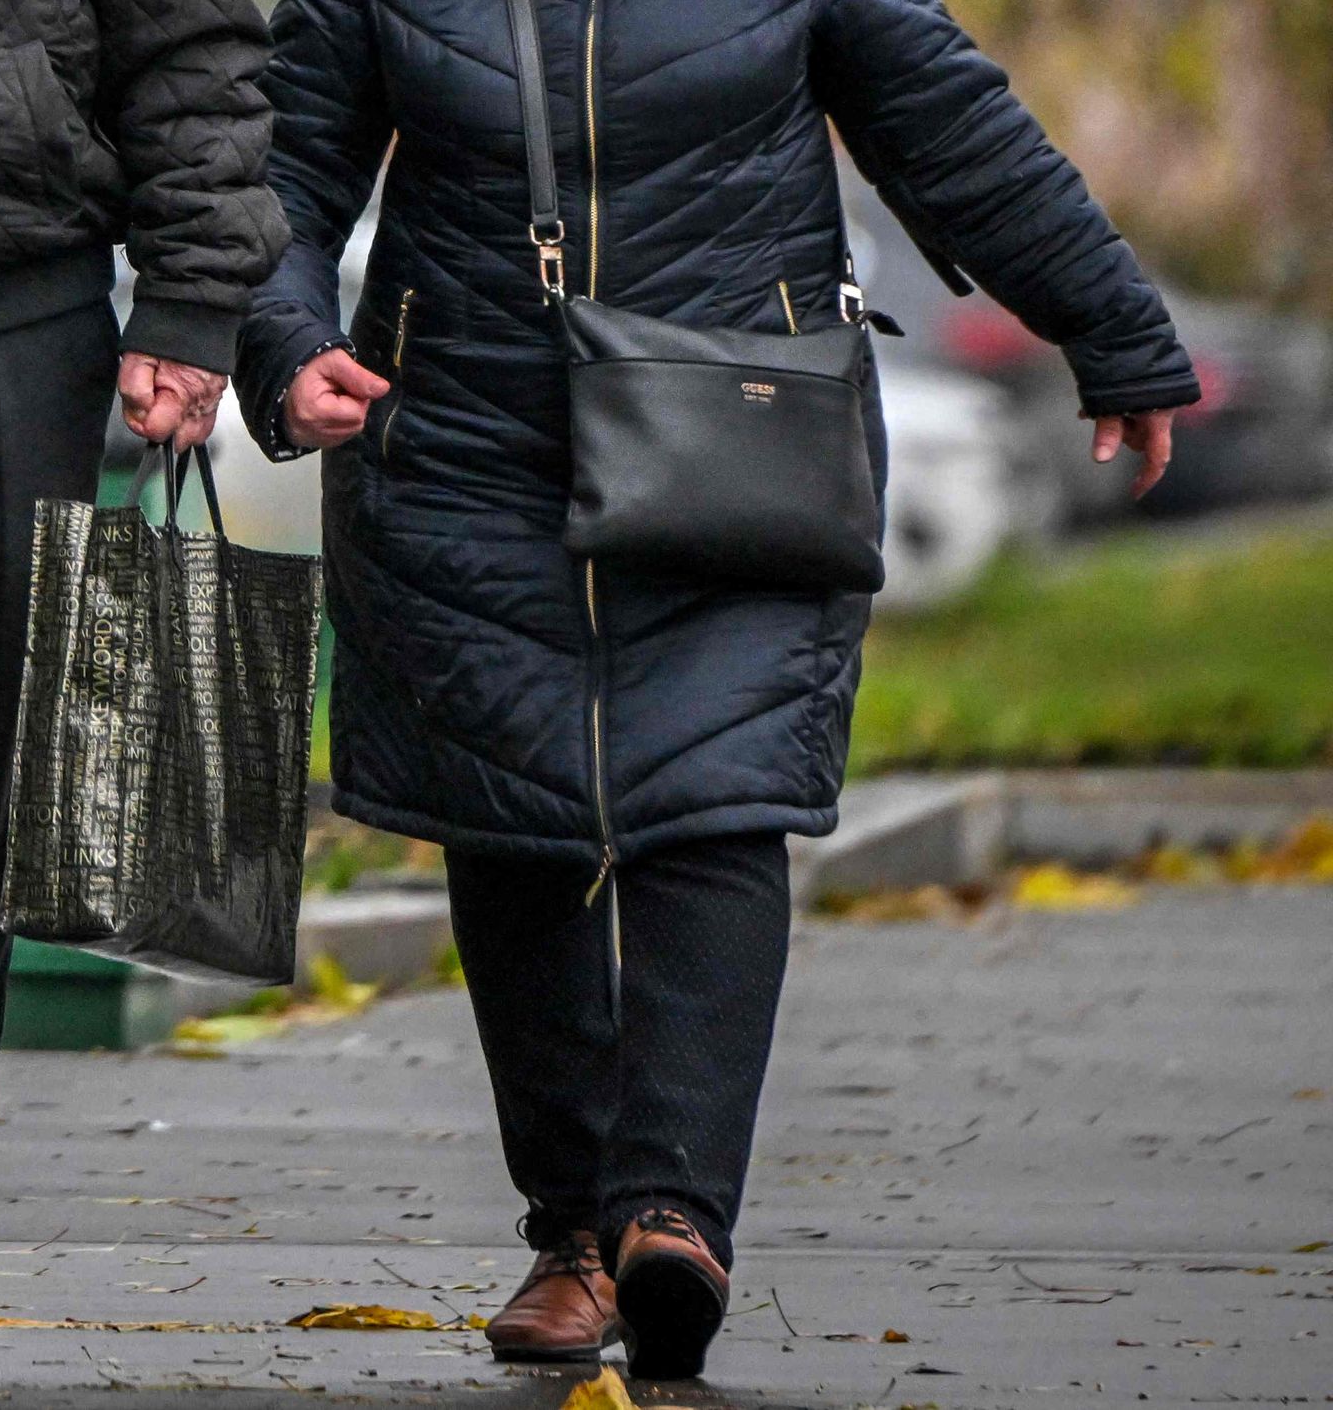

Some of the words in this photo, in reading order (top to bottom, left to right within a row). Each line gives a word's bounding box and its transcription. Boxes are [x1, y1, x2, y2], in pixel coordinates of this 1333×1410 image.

[741, 382, 776, 396] GUESS
[90, 607, 114, 727] KEYWORDS
[63, 846, 118, 869] LINKS
